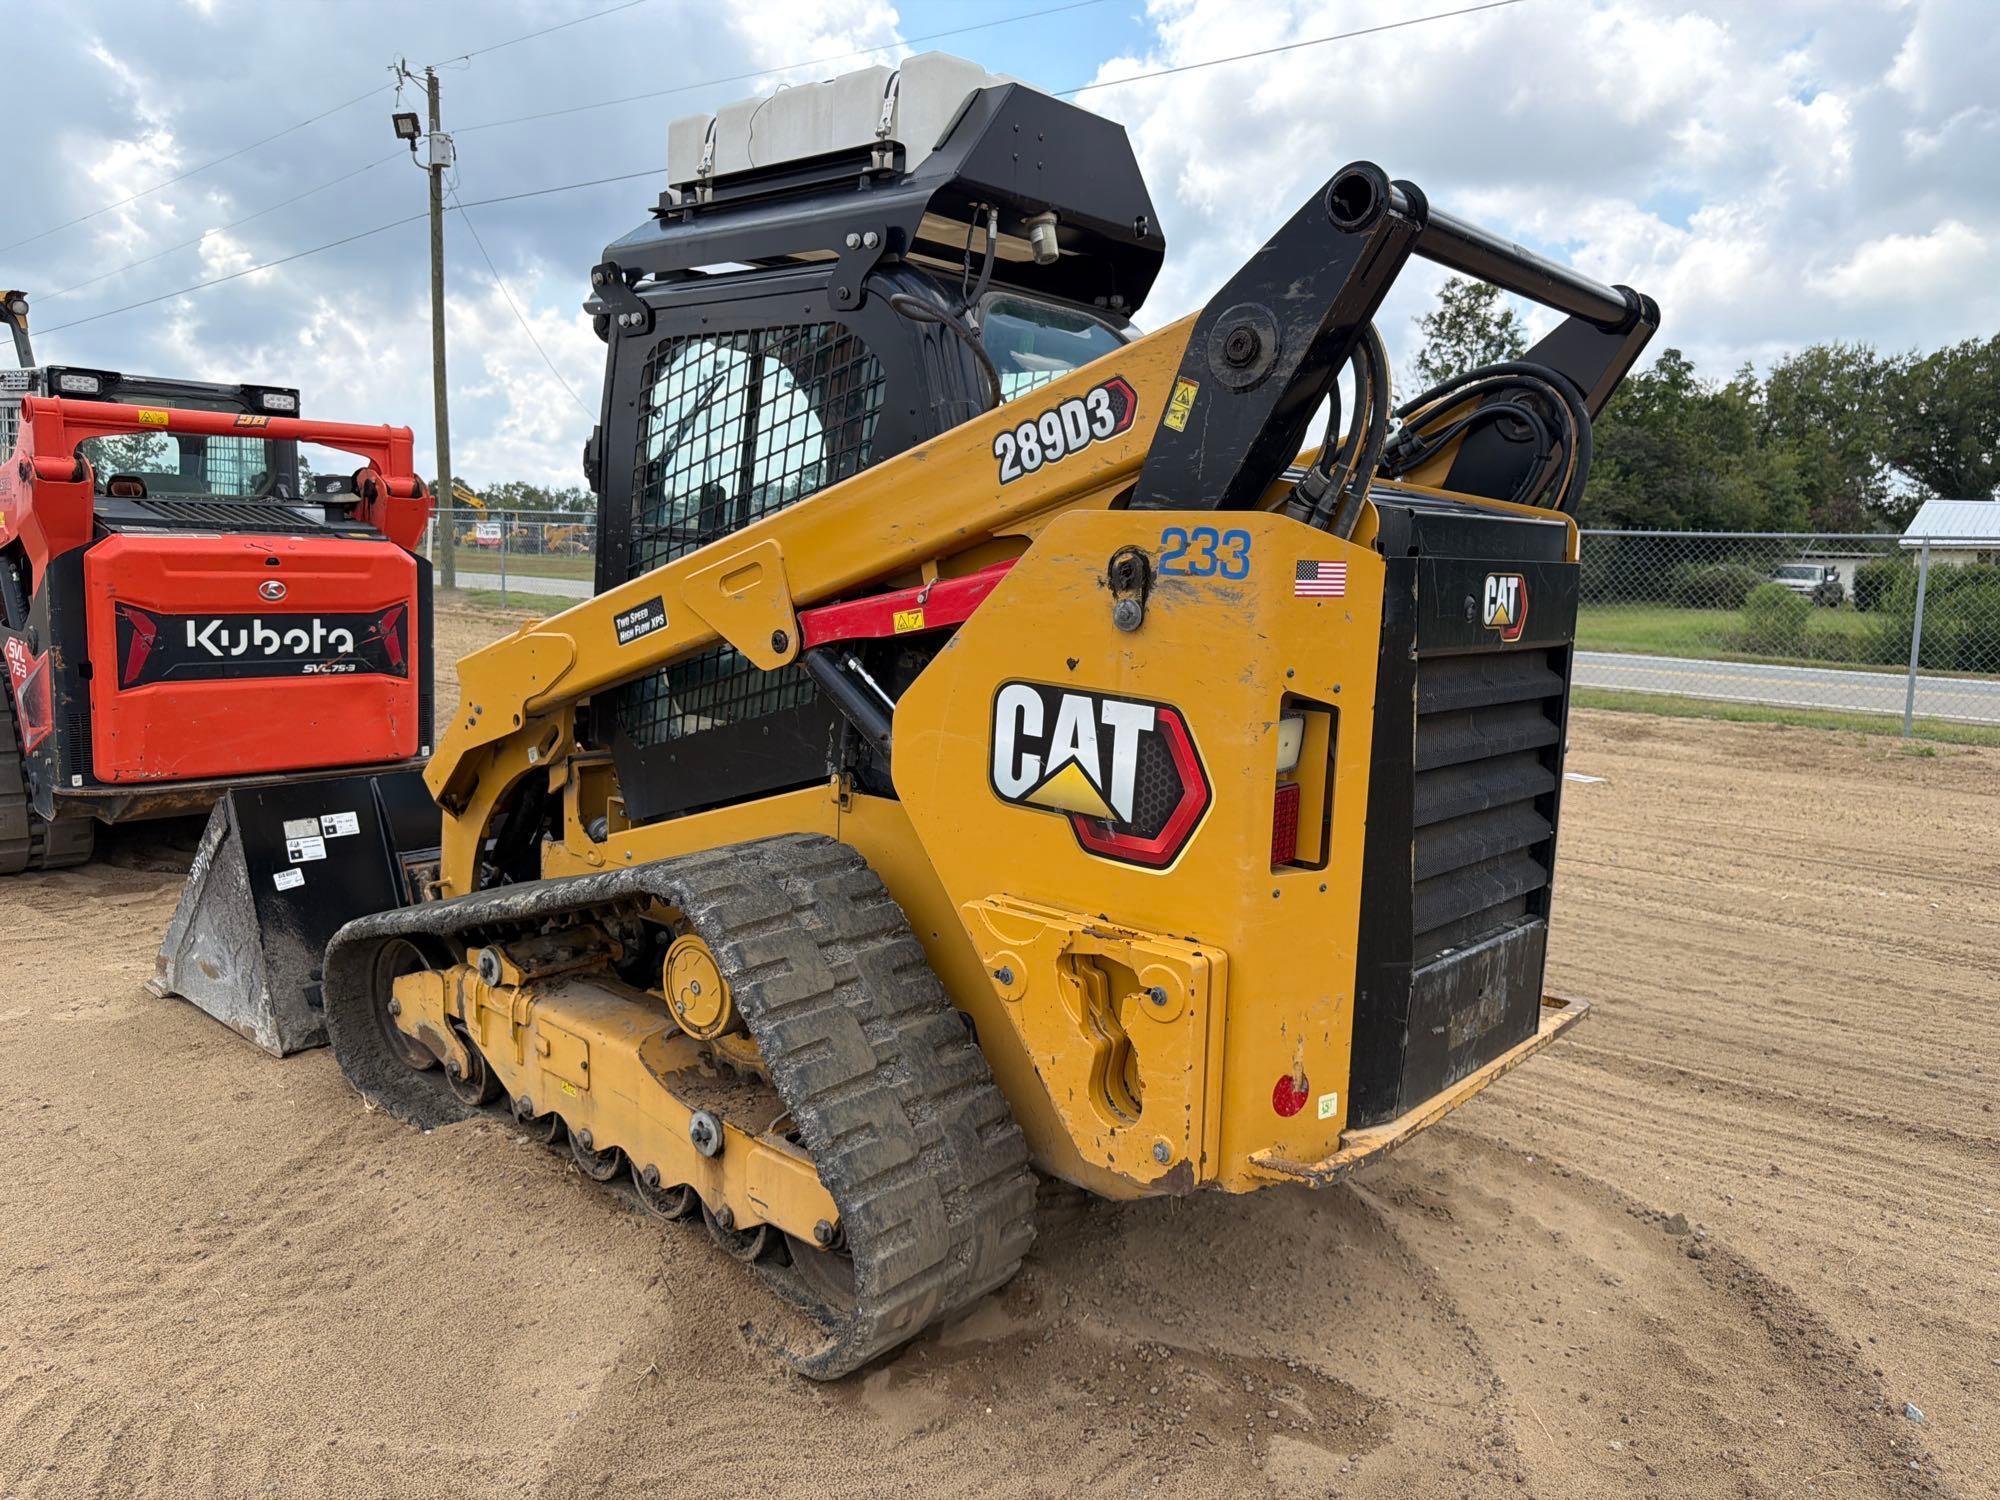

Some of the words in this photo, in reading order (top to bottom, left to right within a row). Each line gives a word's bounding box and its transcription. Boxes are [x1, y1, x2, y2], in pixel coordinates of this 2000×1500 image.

[994, 387, 1115, 482] 289D3
[1158, 526, 1251, 581] 233
[651, 614, 665, 629] XPS
[1484, 576, 1519, 625] CAT
[9, 641, 26, 663] SVL
[186, 618, 354, 656] Kubota
[993, 684, 1156, 824] CAT
